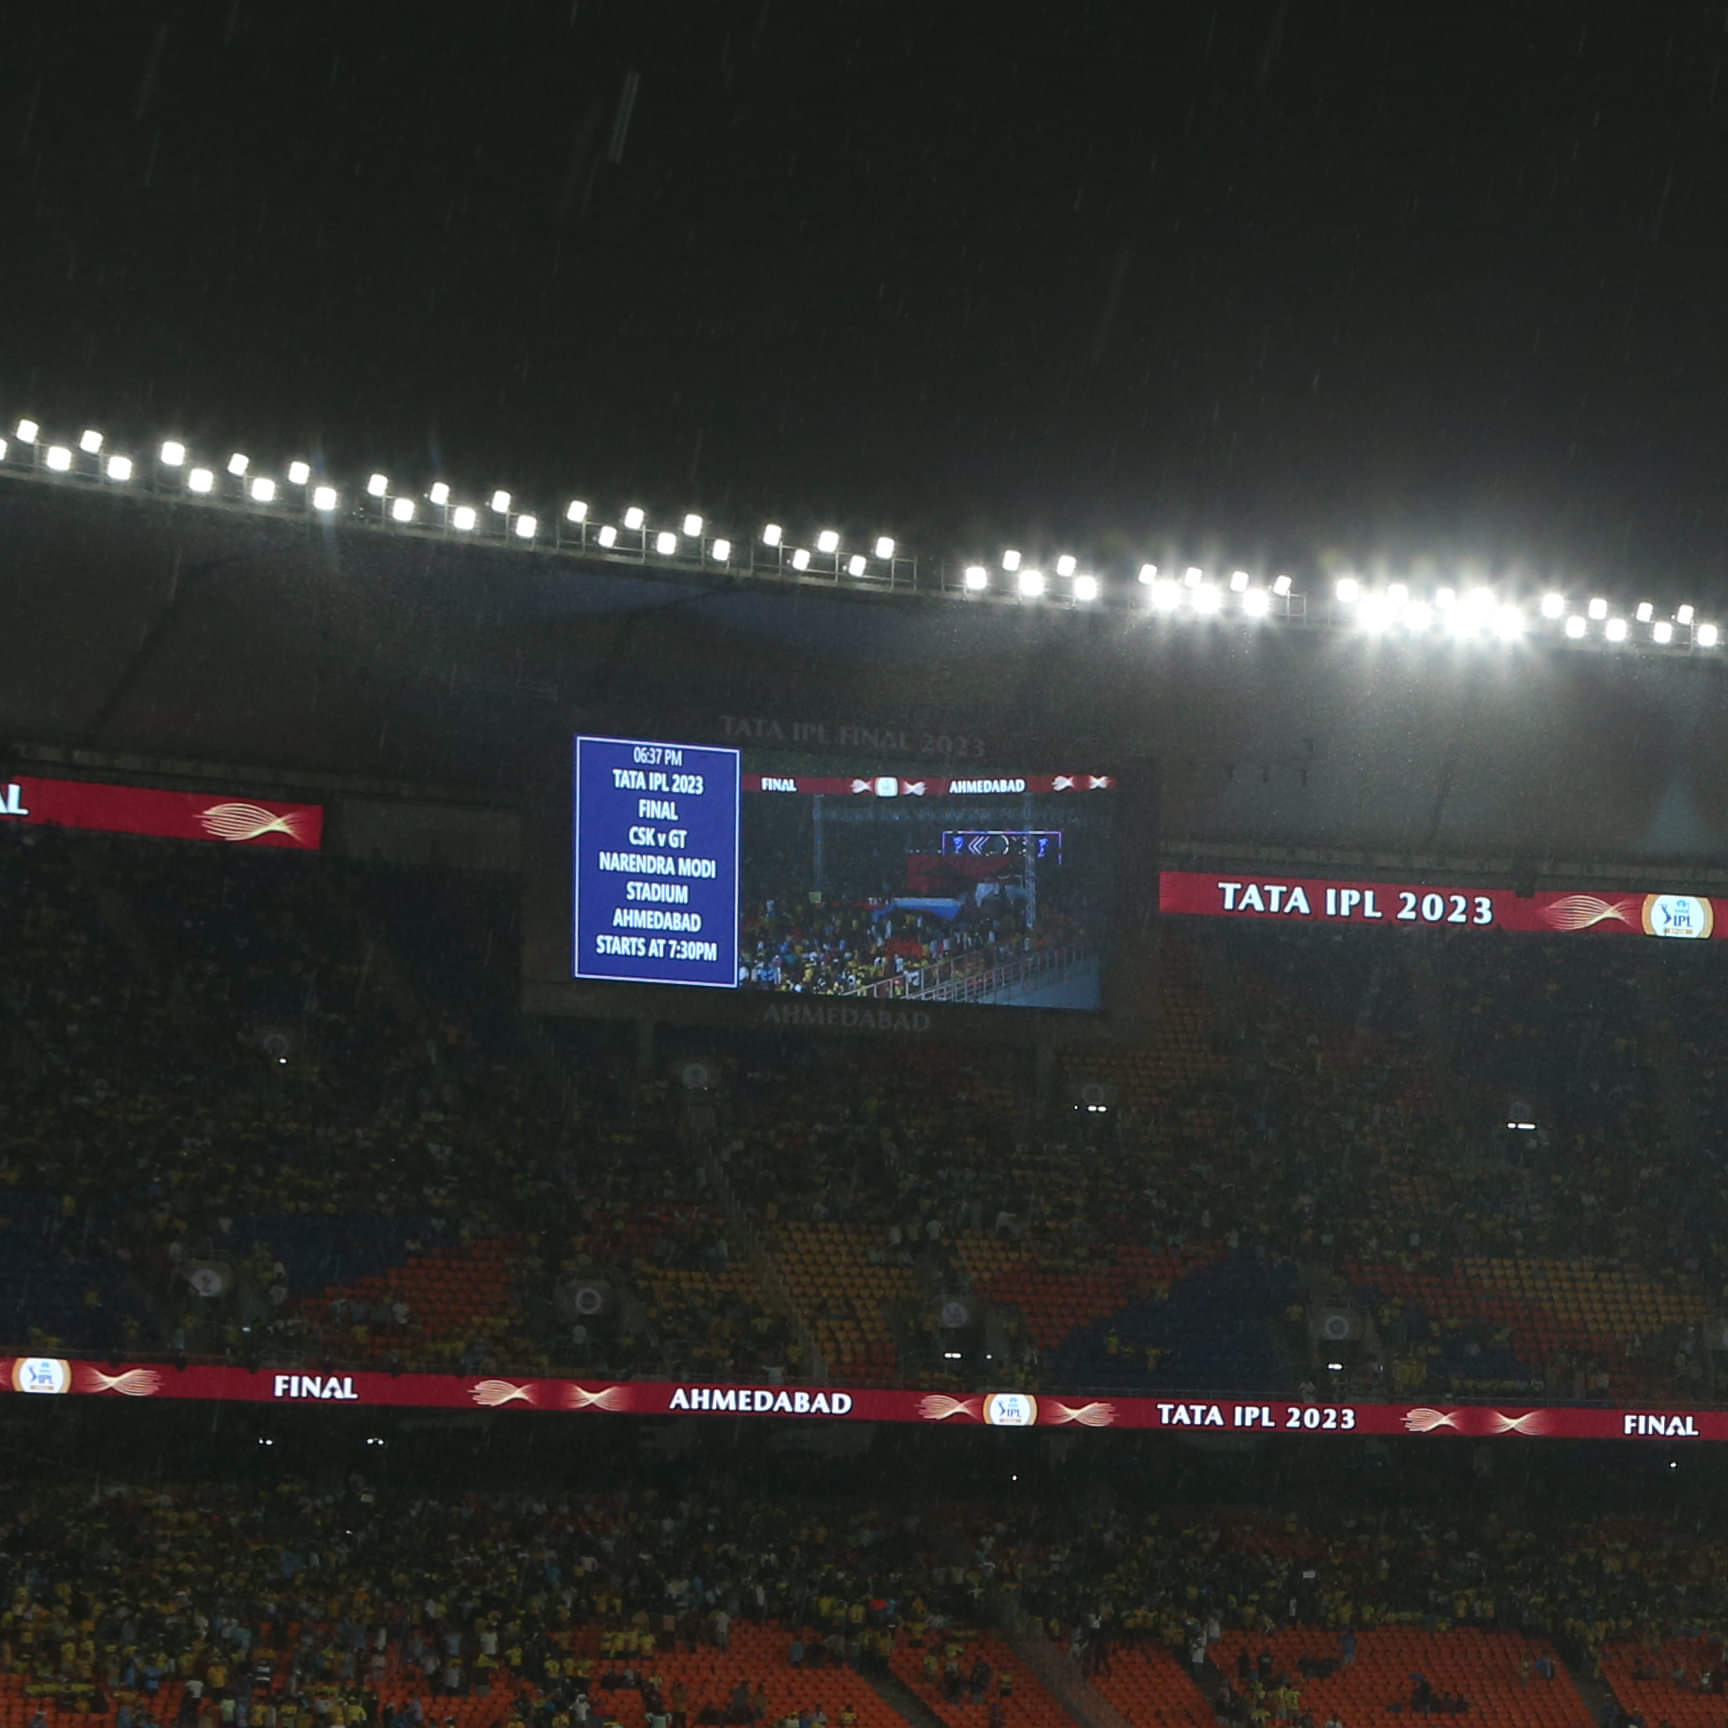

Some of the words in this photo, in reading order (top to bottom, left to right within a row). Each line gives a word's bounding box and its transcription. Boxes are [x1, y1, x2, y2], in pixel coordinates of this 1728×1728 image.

[720, 716, 785, 739] TATA
[793, 722, 832, 743] IPL
[840, 726, 912, 752] FINAL
[921, 731, 986, 758] 2023
[633, 747, 662, 765] 06:37
[664, 749, 683, 767] PM
[612, 769, 647, 791] TATA
[648, 772, 670, 793] IPL
[671, 775, 704, 795] 2023
[760, 776, 798, 792] FINAL
[949, 778, 1026, 795] AHMEDABAD
[638, 799, 679, 821] FINAL
[628, 827, 655, 848] CSK
[657, 833, 667, 848] v
[668, 829, 687, 849] GT
[599, 852, 677, 877] NARENDRA
[678, 856, 717, 879] MODI
[626, 881, 689, 904] STADIUM
[1217, 881, 1310, 914] TATA
[1326, 887, 1382, 918] IPL
[1396, 890, 1492, 924] 2023
[612, 908, 702, 932] AHMEDABAD
[596, 934, 647, 958] STARTS
[648, 938, 667, 958] AT
[669, 940, 718, 963] 7:30PM
[764, 1004, 931, 1033] AHMEDABAD
[274, 1375, 358, 1399] FINAL
[669, 1388, 852, 1414] AHMEDABAD
[1156, 1403, 1224, 1426] TATA
[1234, 1406, 1276, 1427] IPL
[1285, 1407, 1355, 1429] 2023
[1624, 1414, 1699, 1436] FINAL
